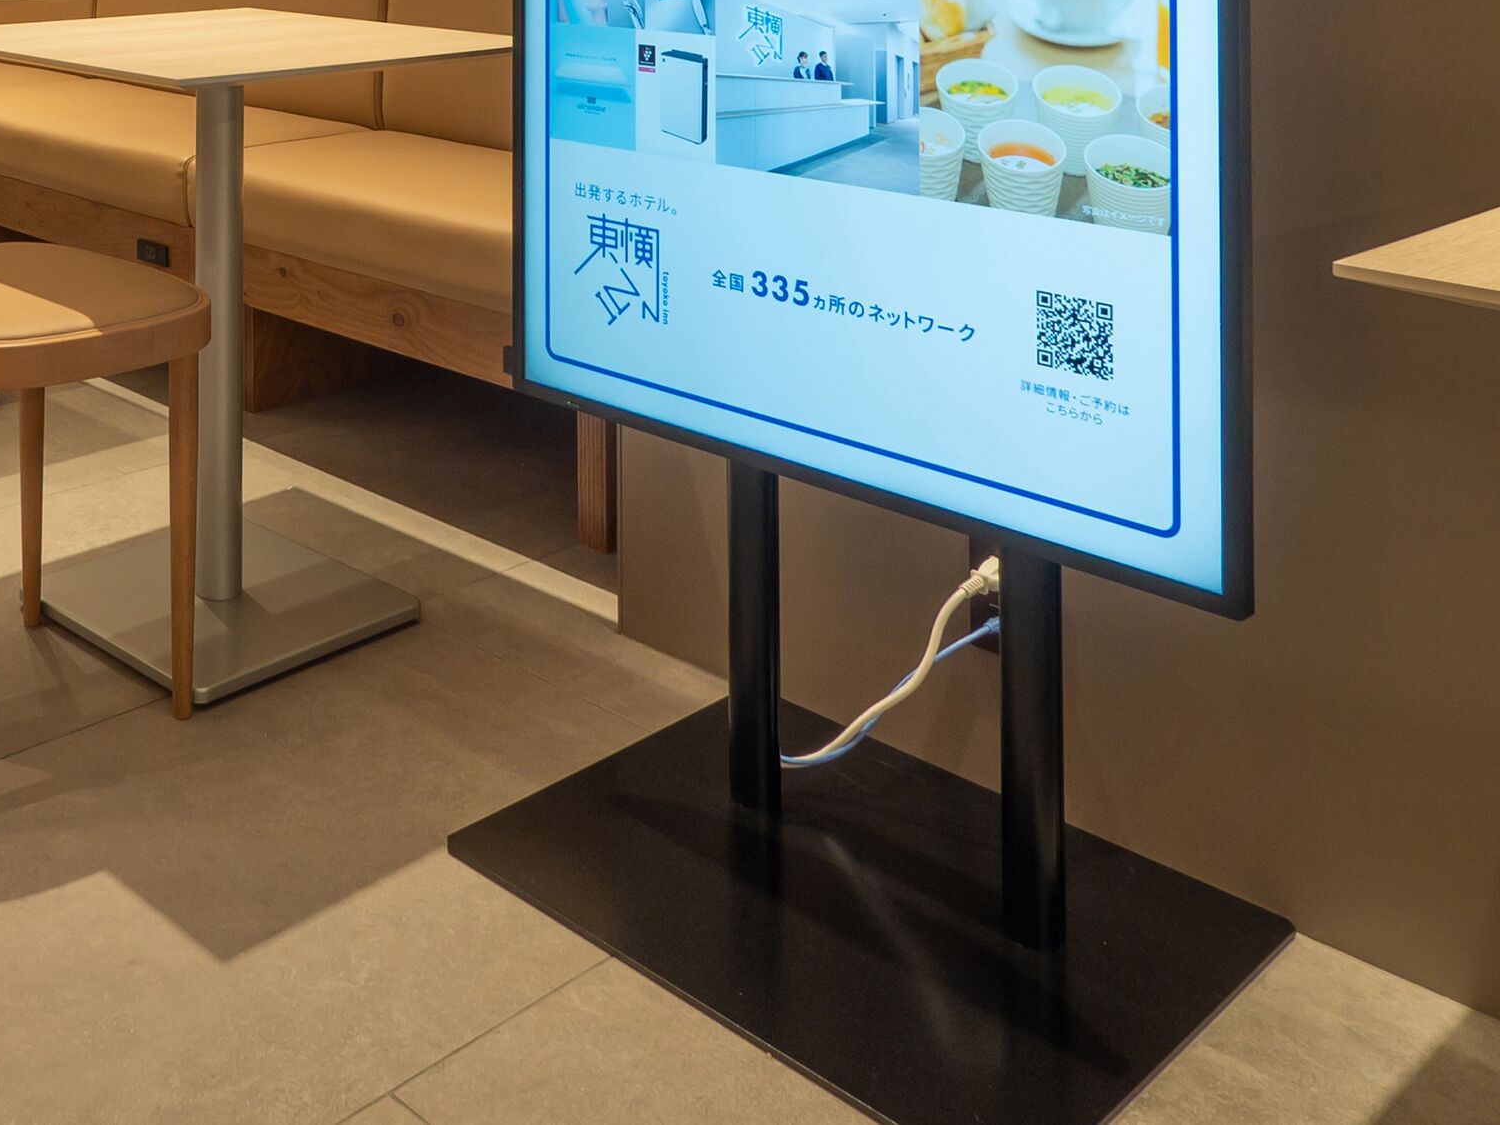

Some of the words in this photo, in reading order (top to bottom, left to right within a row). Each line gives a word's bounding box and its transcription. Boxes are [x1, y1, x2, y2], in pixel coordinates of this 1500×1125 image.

[574, 181, 677, 216] 出発するホテル。
[1046, 402, 1104, 426] こちらから
